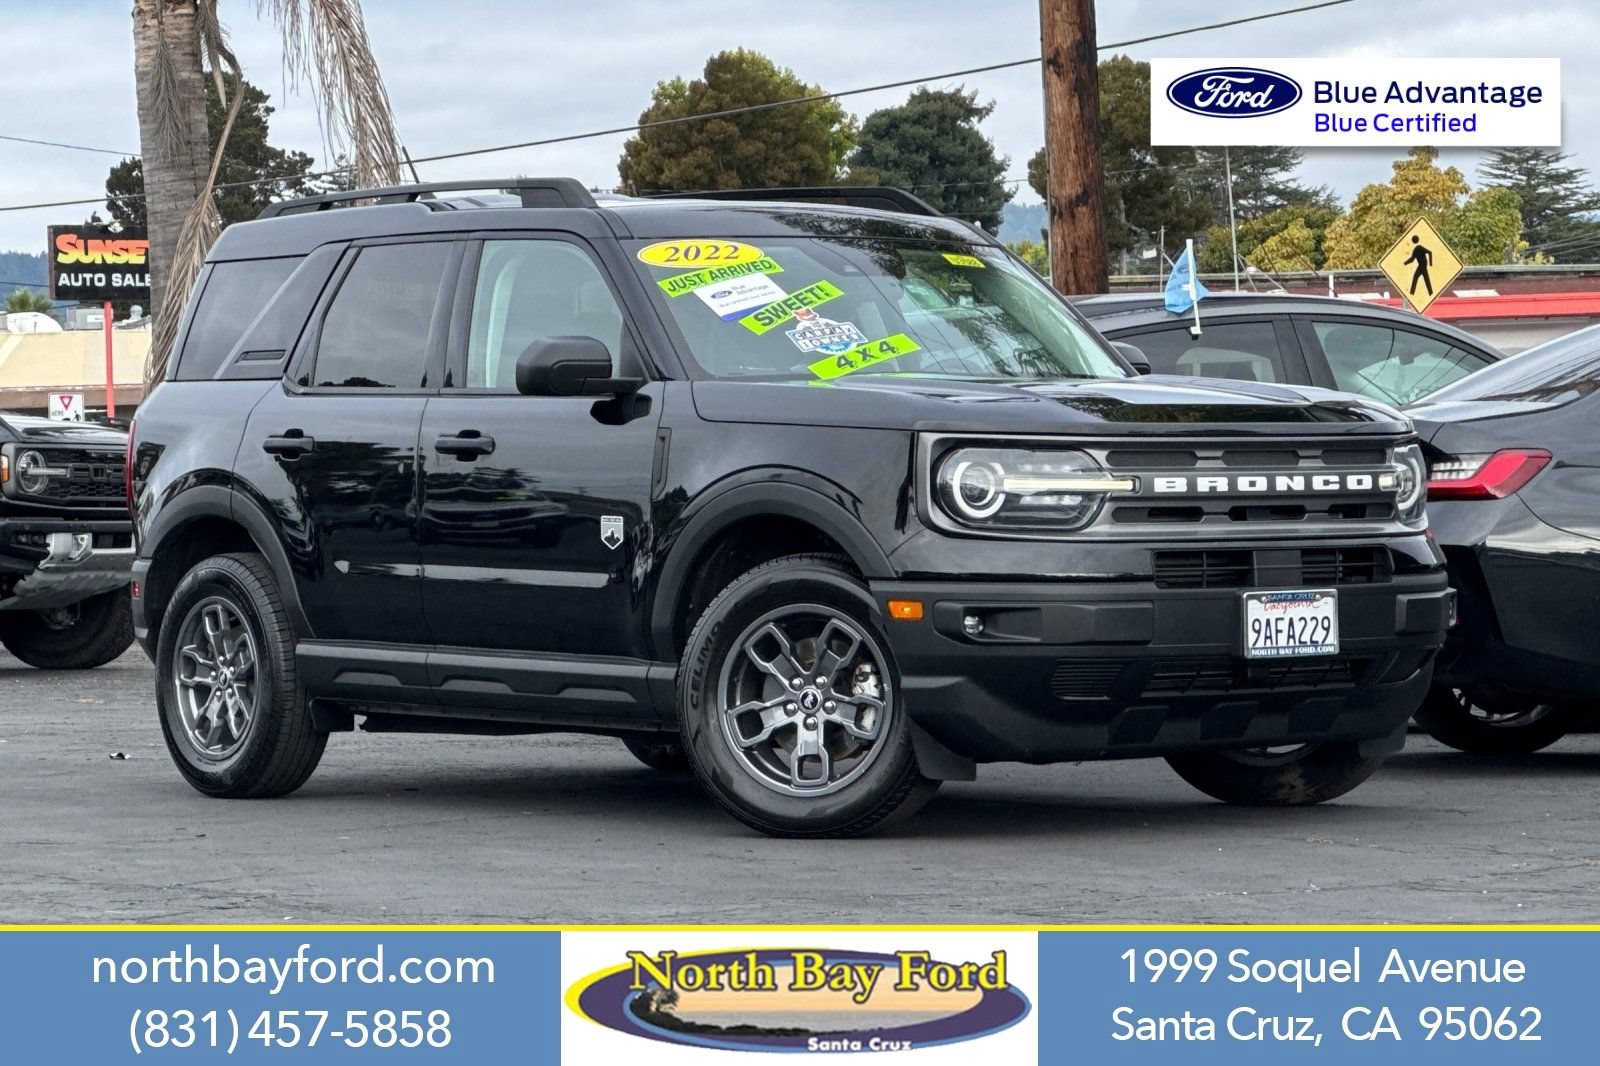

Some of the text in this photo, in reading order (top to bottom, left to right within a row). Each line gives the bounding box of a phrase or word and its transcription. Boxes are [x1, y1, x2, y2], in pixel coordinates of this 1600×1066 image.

[56, 233, 148, 264] SUNSE
[664, 244, 740, 262] 2022
[58, 273, 107, 287] AUTO
[667, 259, 776, 293] JUST ARRIVED
[752, 284, 832, 327] SWEET!
[1153, 473, 1374, 493] BRONCO
[1294, 592, 1316, 600] CRUZ
[1251, 616, 1331, 647] 9AFA229
[1251, 645, 1335, 656] NORTH BAY FORD.COM
